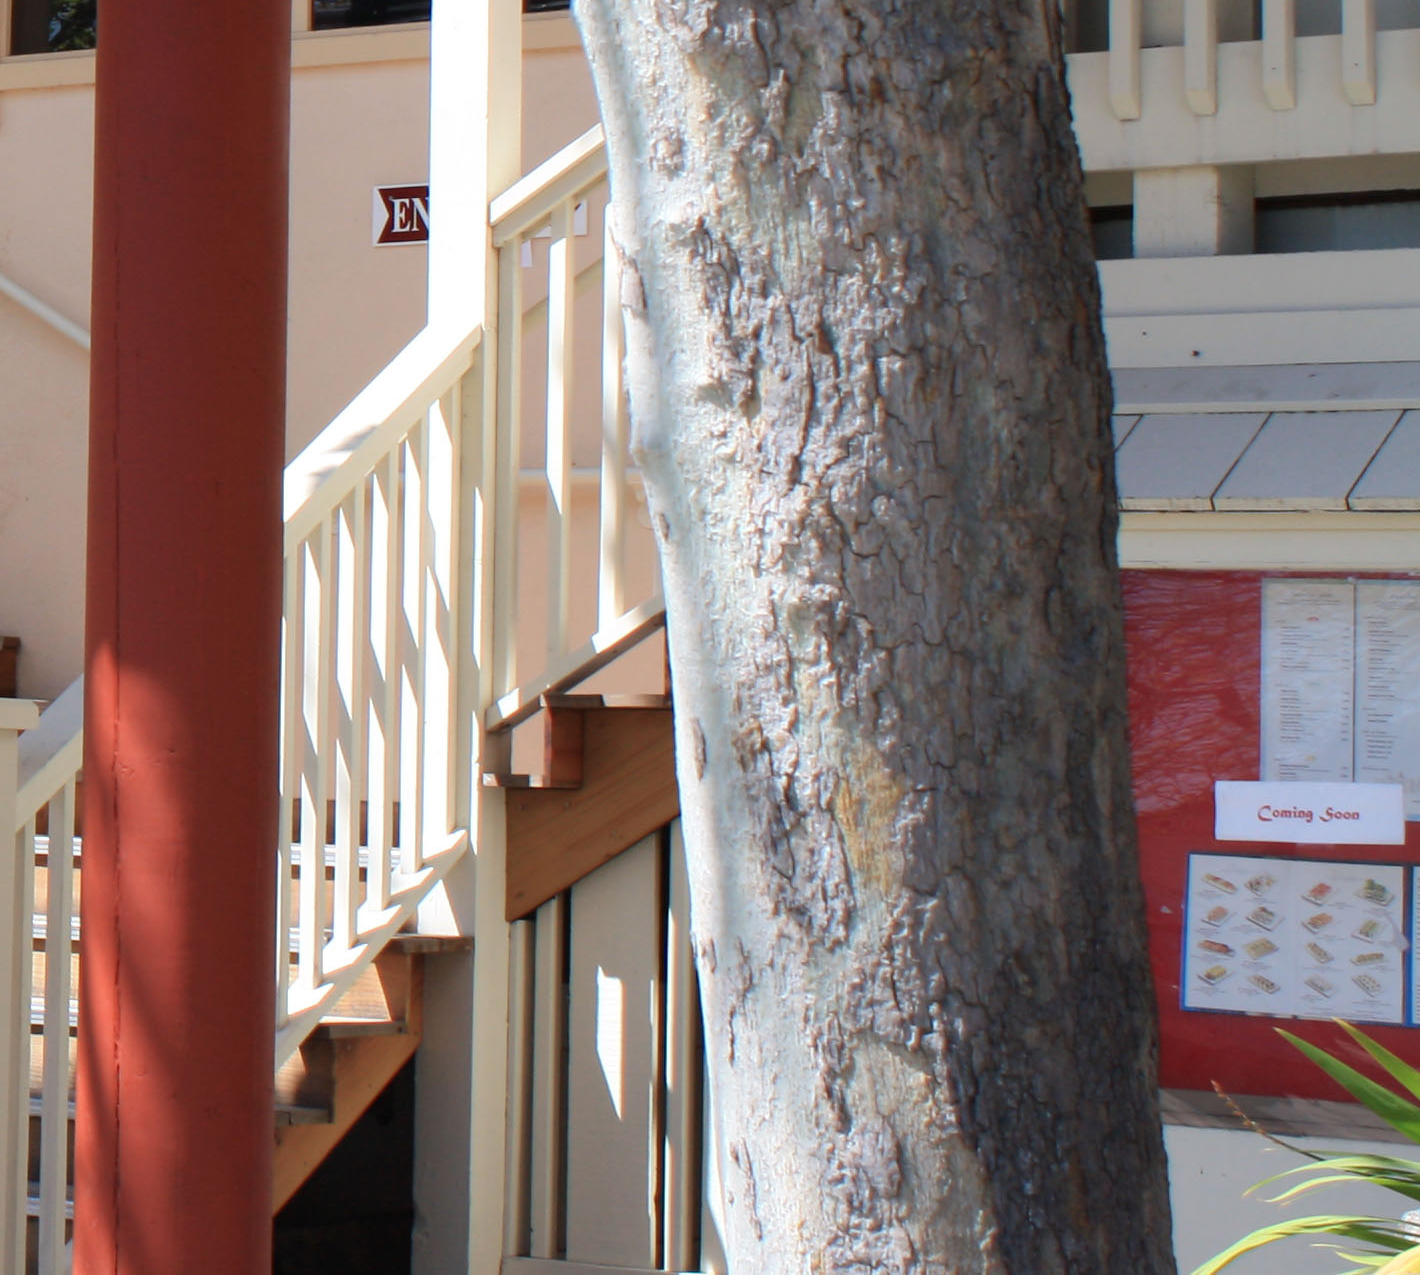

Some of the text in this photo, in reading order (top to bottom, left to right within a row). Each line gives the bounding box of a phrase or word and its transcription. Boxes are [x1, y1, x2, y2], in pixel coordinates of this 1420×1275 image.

[389, 197, 430, 233] EN
[1257, 805, 1360, 823] Coming Soon
